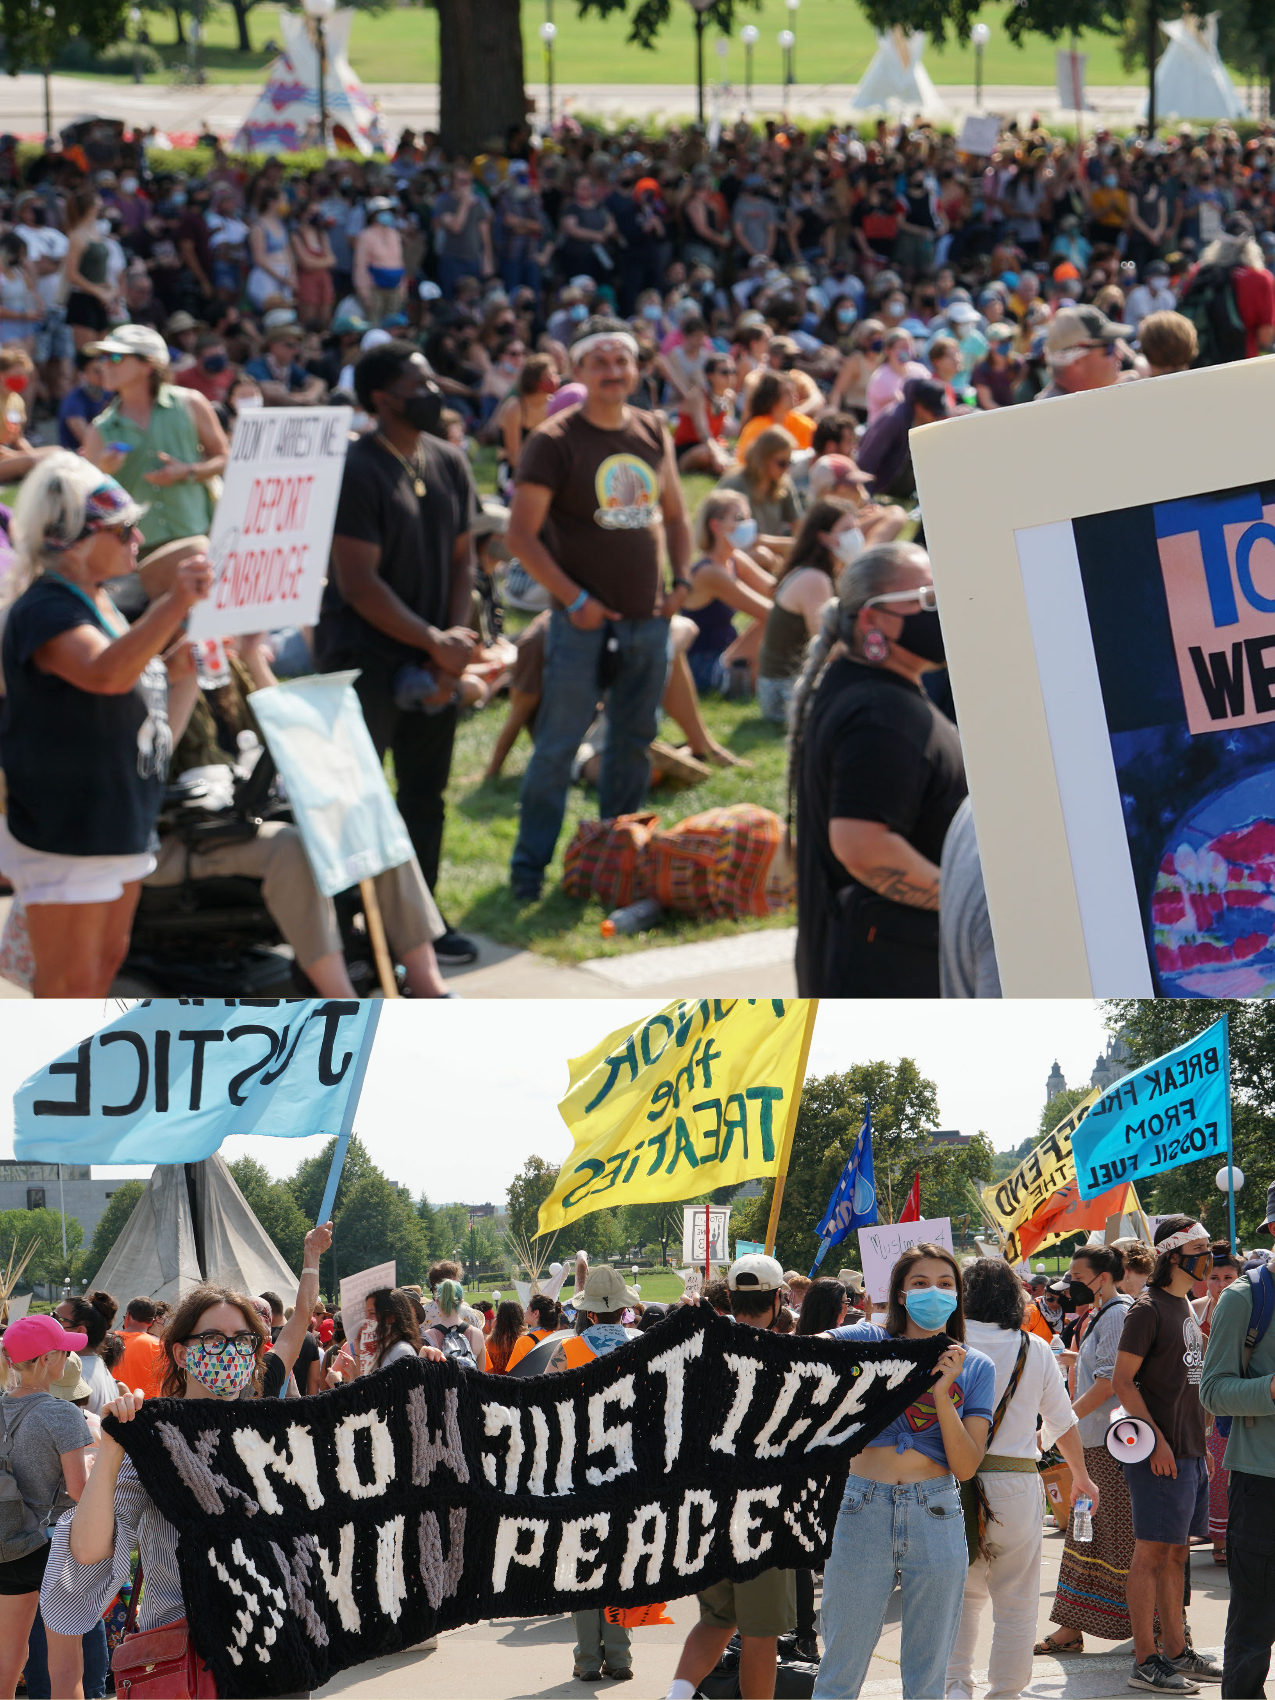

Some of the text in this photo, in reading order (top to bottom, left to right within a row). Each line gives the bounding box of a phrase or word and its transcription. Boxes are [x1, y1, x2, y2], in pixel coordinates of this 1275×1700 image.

[243, 474, 315, 536] DEPORT
[216, 545, 310, 611] ENBRIDGE
[934, 1228, 945, 1248] 4
[481, 1329, 917, 1496] JUSTICE
[491, 1484, 782, 1594] PEACE
